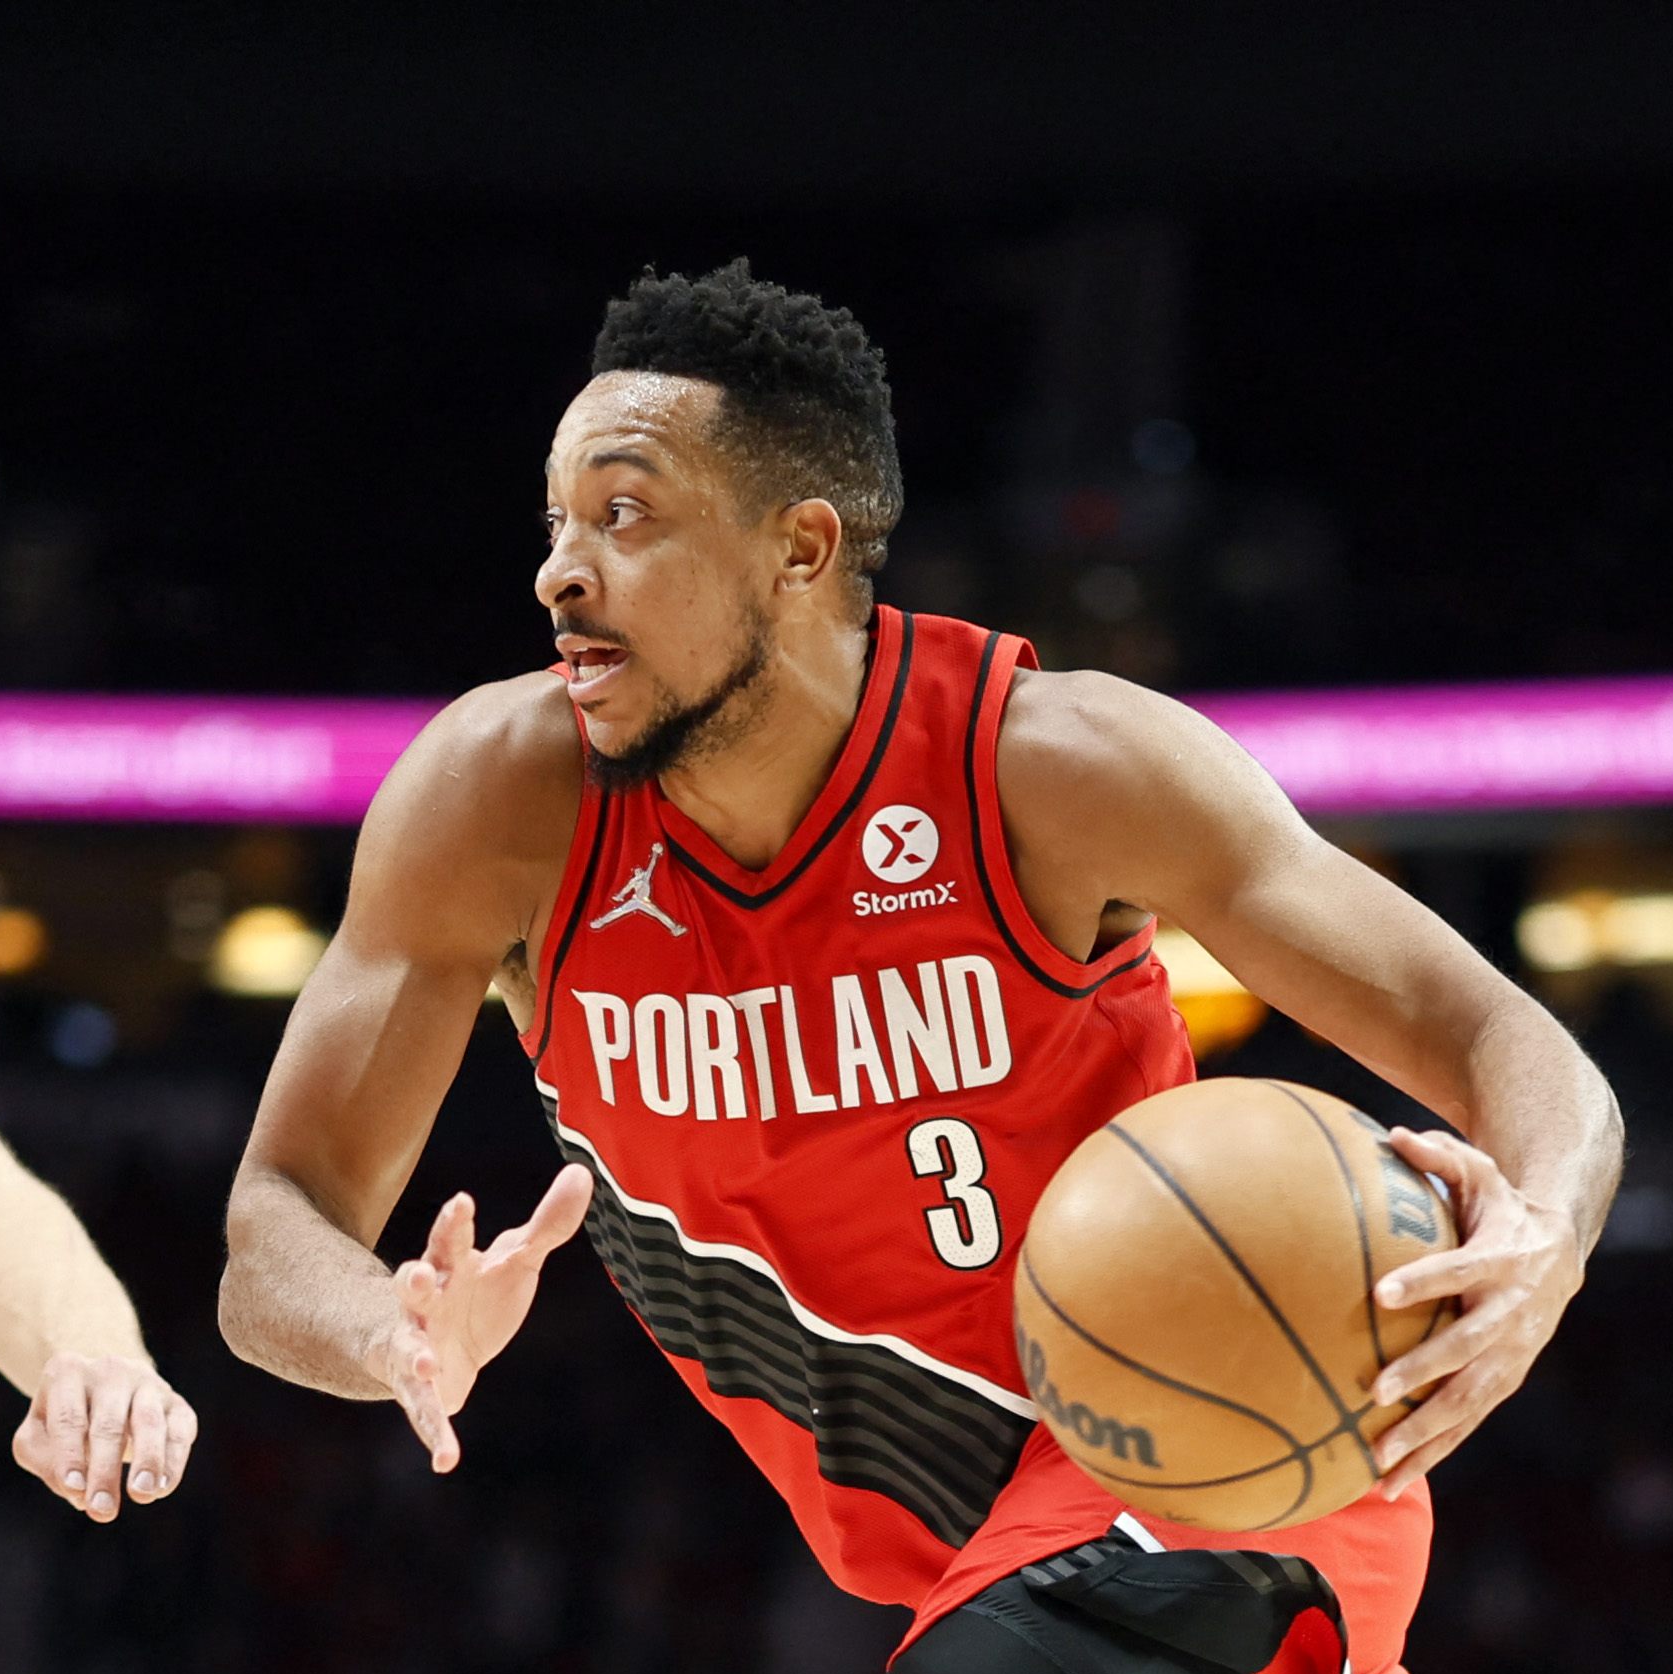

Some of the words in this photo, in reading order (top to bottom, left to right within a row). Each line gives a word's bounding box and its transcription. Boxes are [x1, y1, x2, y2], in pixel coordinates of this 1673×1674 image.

[852, 880, 960, 917] StormX
[570, 955, 1014, 1122] PORTLAND
[905, 1116, 1003, 1272] 3
